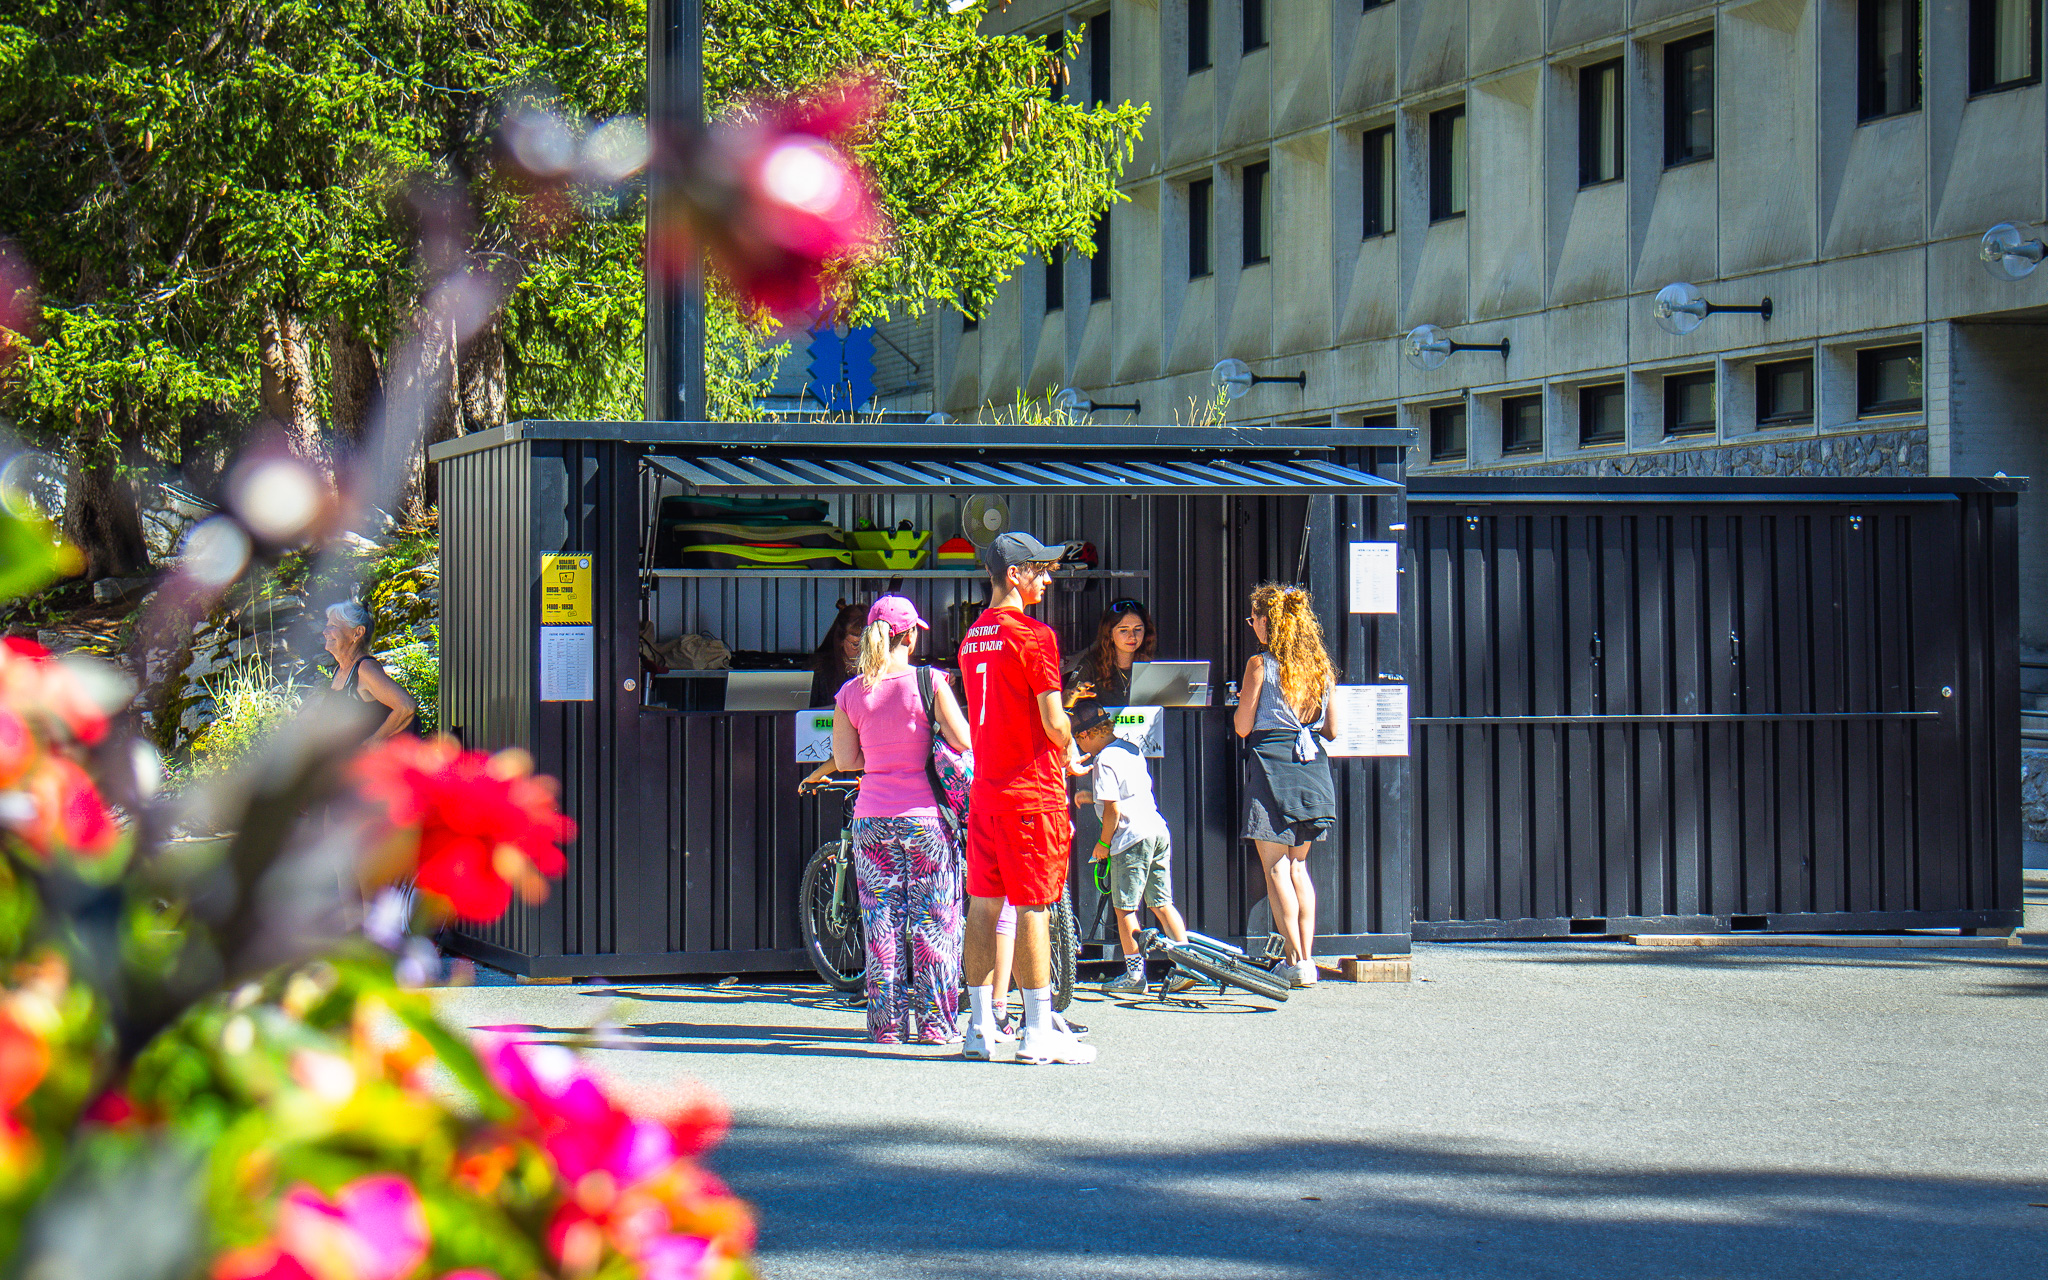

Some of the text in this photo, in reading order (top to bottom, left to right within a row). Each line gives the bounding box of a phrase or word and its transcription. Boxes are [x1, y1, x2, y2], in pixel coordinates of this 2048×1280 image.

[967, 624, 1001, 639] DISTRICT
[979, 640, 1004, 653] D'AZUR
[1114, 715, 1145, 724] FILE B
